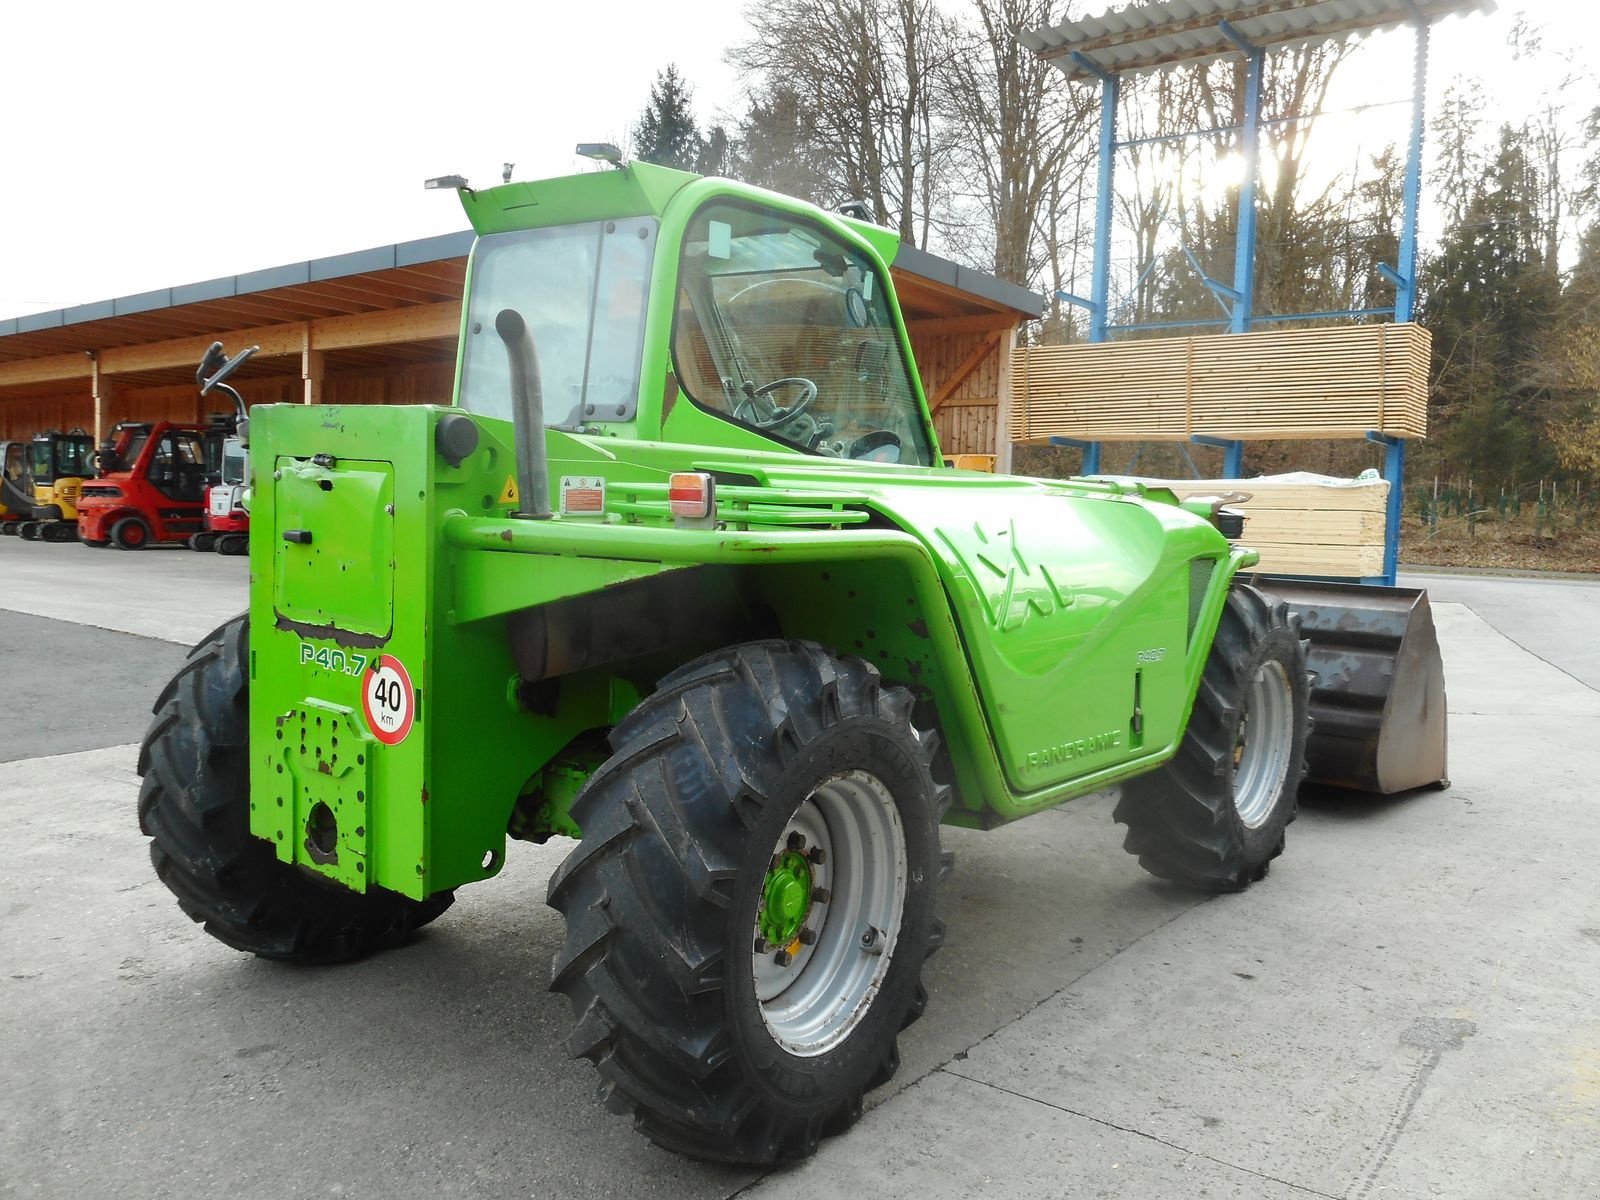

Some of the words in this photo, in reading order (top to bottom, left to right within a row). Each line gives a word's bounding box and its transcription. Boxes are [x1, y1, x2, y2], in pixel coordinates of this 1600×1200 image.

[300, 643, 366, 676] P40.7
[375, 678, 401, 712] 40
[381, 711, 394, 726] km
